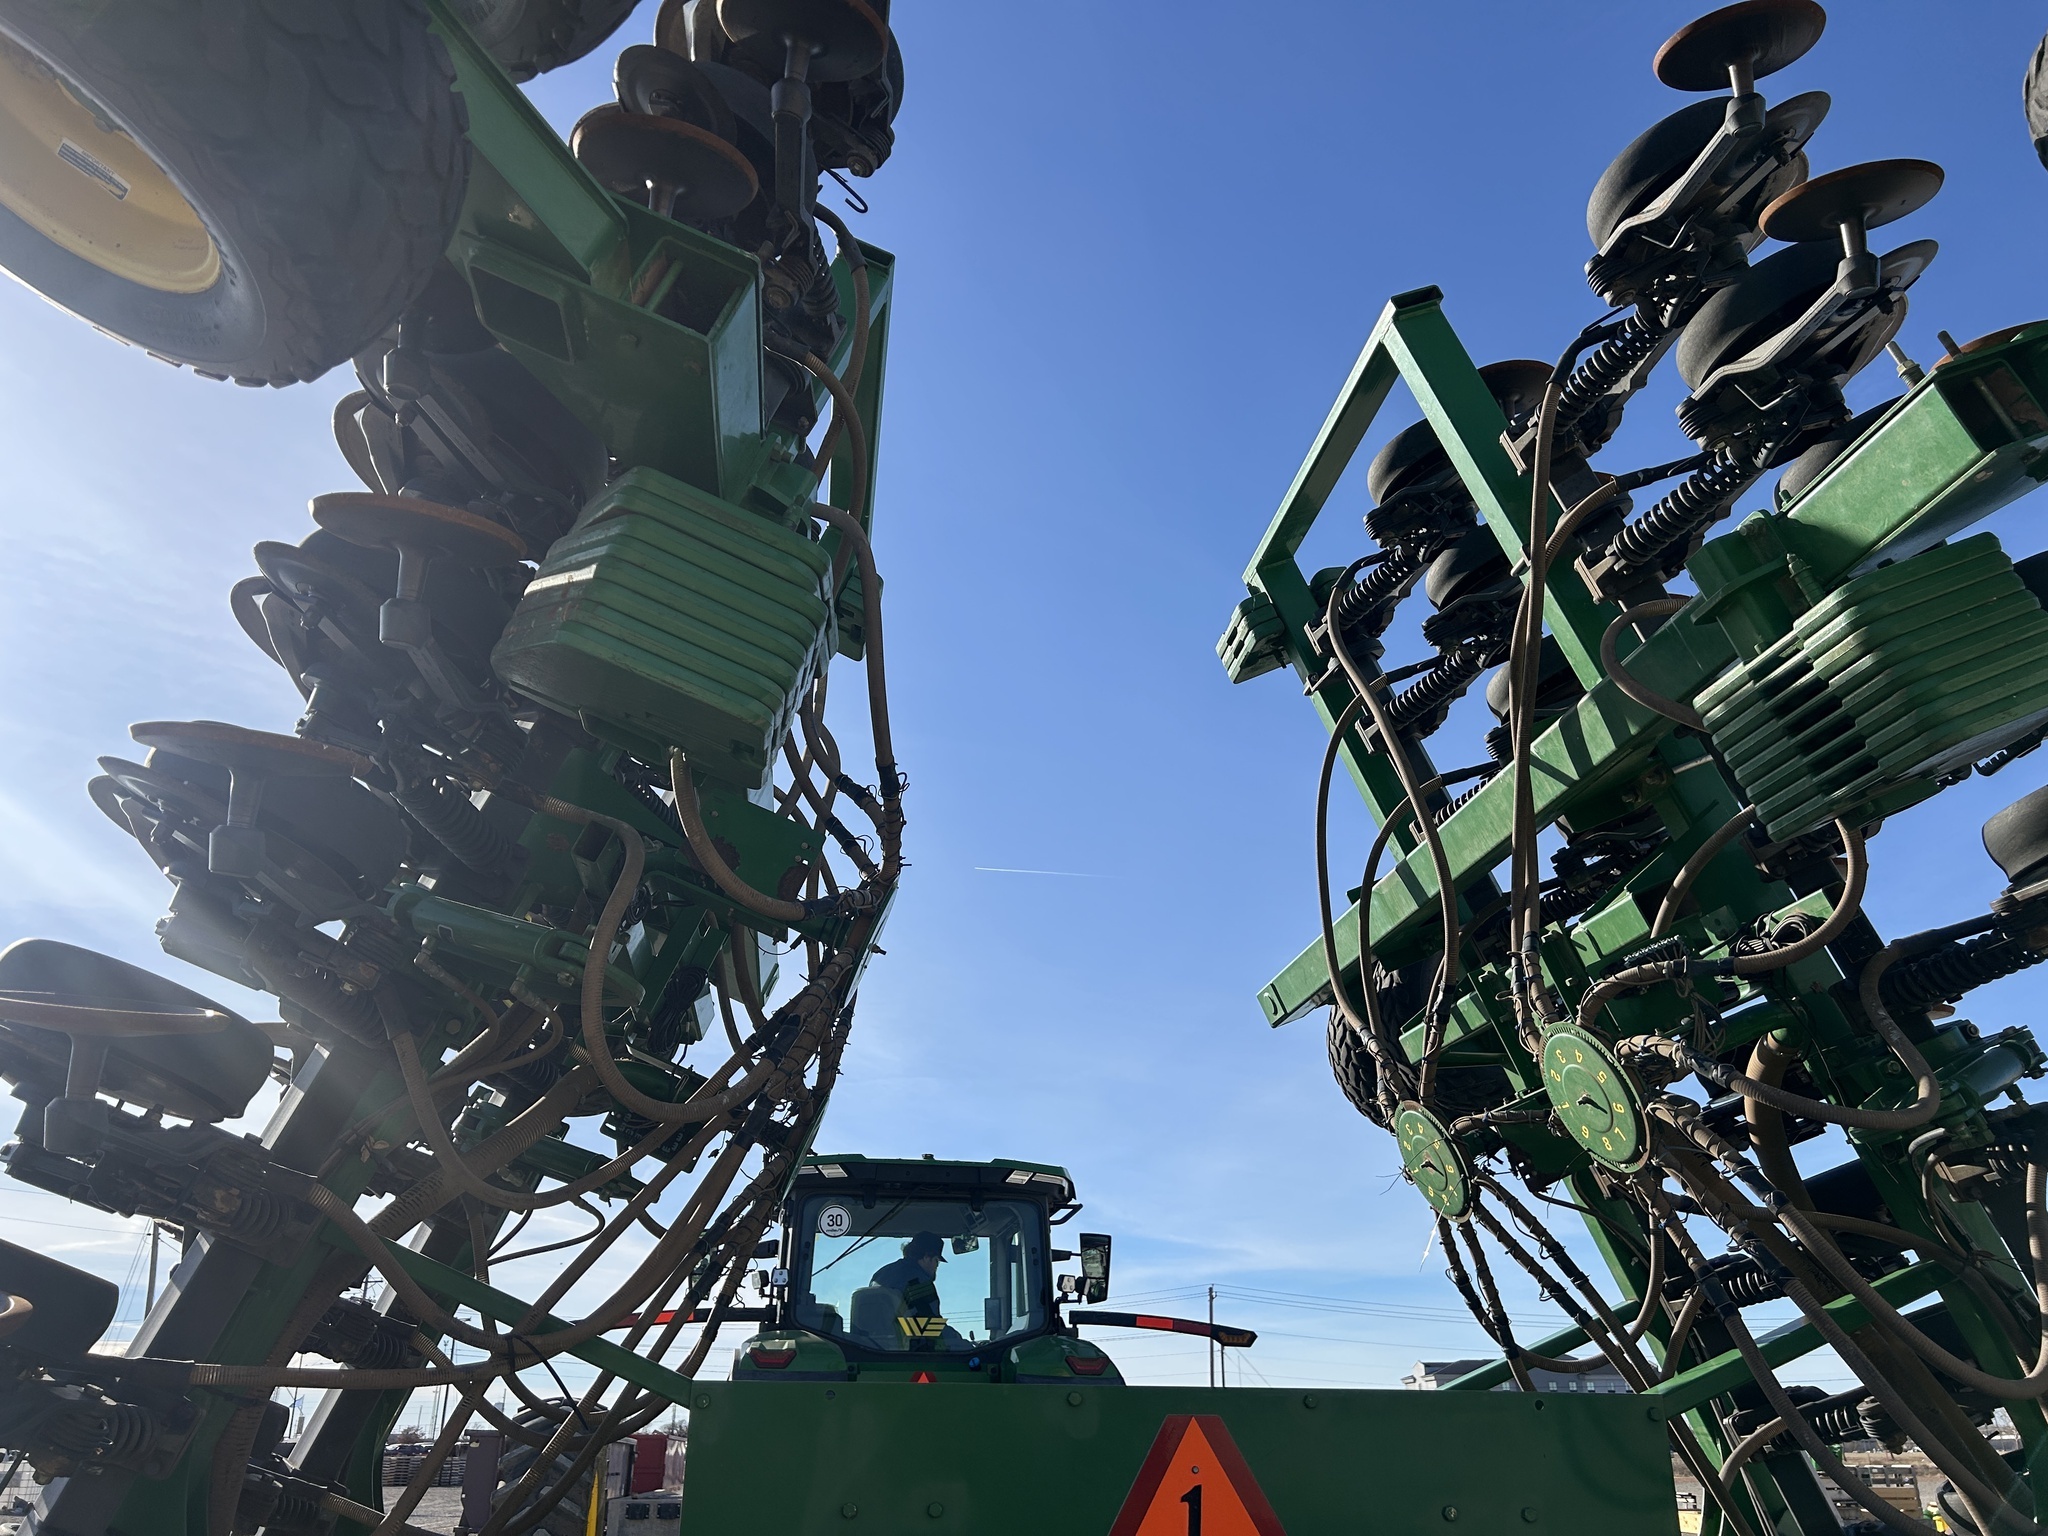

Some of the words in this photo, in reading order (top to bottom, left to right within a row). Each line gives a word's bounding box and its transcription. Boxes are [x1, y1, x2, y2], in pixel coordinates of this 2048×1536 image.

[81, 150, 115, 176] IMPORTANT
[1555, 1049, 1566, 1064] 3
[1574, 1049, 1583, 1063] 4
[1550, 1069, 1561, 1082] 2
[1597, 1070, 1607, 1084] 5
[1612, 1102, 1625, 1113] 6
[1405, 1123, 1413, 1136] 3
[1417, 1123, 1424, 1134] 4
[1581, 1125, 1589, 1139] 9
[1613, 1126, 1626, 1142] 7
[1601, 1136, 1613, 1152] 8
[827, 1213, 843, 1227] 30
[1180, 1484, 1202, 1536] 1
